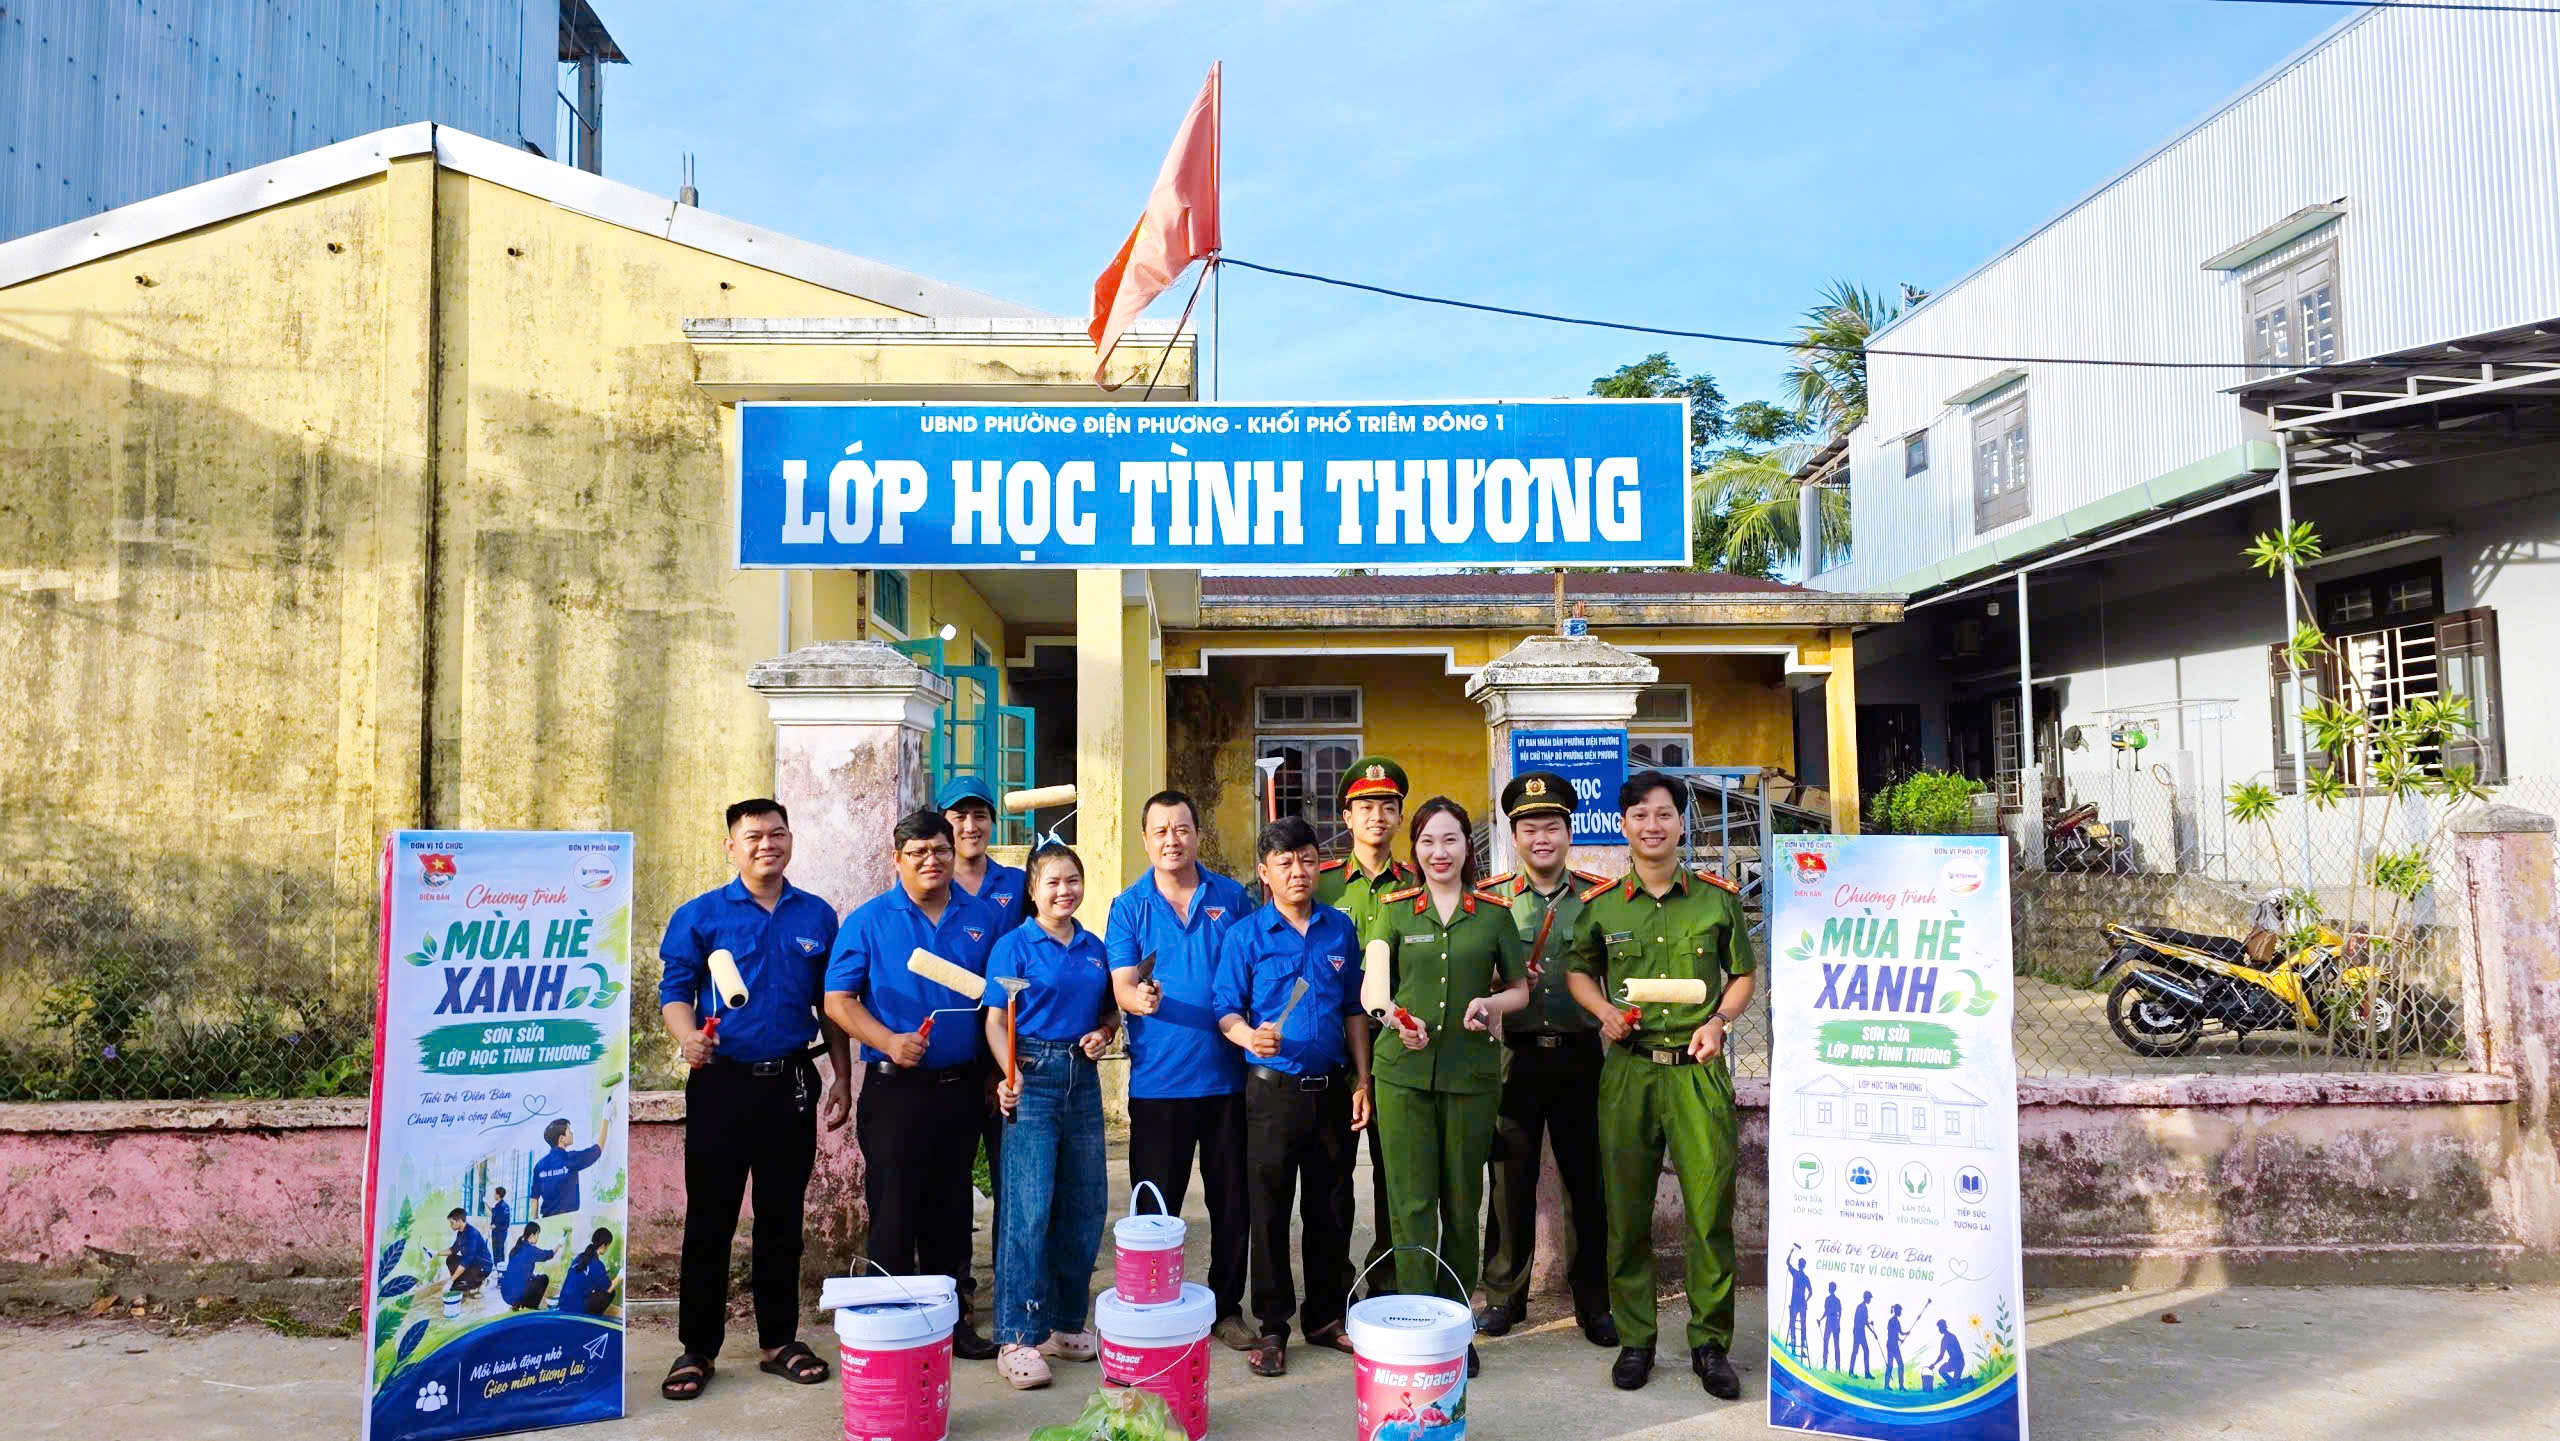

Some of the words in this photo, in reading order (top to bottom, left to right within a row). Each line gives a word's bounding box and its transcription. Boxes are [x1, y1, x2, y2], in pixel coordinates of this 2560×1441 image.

[921, 415, 977, 432] UBND
[985, 411, 1076, 433] PHƯỜNG
[1084, 412, 1130, 437] ĐIỆN
[1138, 414, 1228, 433] PHƯƠNG
[1248, 409, 1299, 433] KHỐI
[1307, 409, 1350, 433] PHỐ
[1358, 411, 1415, 432] TRIÊM
[1423, 410, 1487, 432] ĐÔNG
[1495, 414, 1503, 431] 1
[781, 440, 928, 545] LỚP
[951, 460, 1097, 561] HỌC
[1119, 442, 1304, 546] TÌNH
[1326, 456, 1642, 545] THƯƠNG
[1525, 738, 1537, 747] BAN
[1537, 736, 1552, 747] NHÂN
[1570, 808, 1622, 834] HƯƠNG
[411, 841, 425, 849] ĐƠN
[466, 884, 527, 911] Chương
[532, 886, 568, 905] trình
[1834, 884, 1898, 910] Chương
[1901, 887, 1937, 905] trình
[442, 910, 530, 961] MÙA
[543, 909, 594, 959] HÈ
[1819, 908, 1899, 959] MÙA
[1914, 909, 1966, 961] HÈ
[434, 965, 568, 1015] XANH
[1813, 963, 1939, 1014] XANH
[482, 1026, 514, 1044] SƠN
[516, 1022, 545, 1042] SỬA
[1862, 1025, 1886, 1041] SƠN
[1887, 1023, 1910, 1043] SỬA
[438, 1047, 466, 1067] LỚP
[469, 1049, 499, 1068] HỌC
[503, 1044, 535, 1064] TÌNH
[538, 1044, 592, 1063] THƯƠNG
[1826, 1041, 1849, 1059] LỚP
[1851, 1044, 1875, 1062] HỌC
[1877, 1043, 1904, 1062] TÌNH
[1906, 1046, 1952, 1065] THƯƠNG
[420, 1089, 442, 1105] Tuổi
[461, 1090, 486, 1103] Điện
[489, 1088, 512, 1101] Bàn
[407, 1112, 438, 1128] Chung
[440, 1113, 456, 1127] tay
[468, 1111, 488, 1125] cộng
[490, 1108, 512, 1123] đồng
[1816, 1259, 1847, 1273] CHUNG
[1850, 1262, 1866, 1274] TAY
[470, 1362, 492, 1381] Mỗi
[493, 1357, 517, 1375] hành
[520, 1354, 542, 1370] động
[544, 1345, 563, 1362] nhỏ
[484, 1379, 509, 1399] Gieo
[510, 1371, 537, 1390] mầm
[539, 1366, 567, 1384] tương
[569, 1359, 585, 1376] lai
[1374, 1367, 1408, 1387] Nice
[1412, 1369, 1457, 1390] Space
